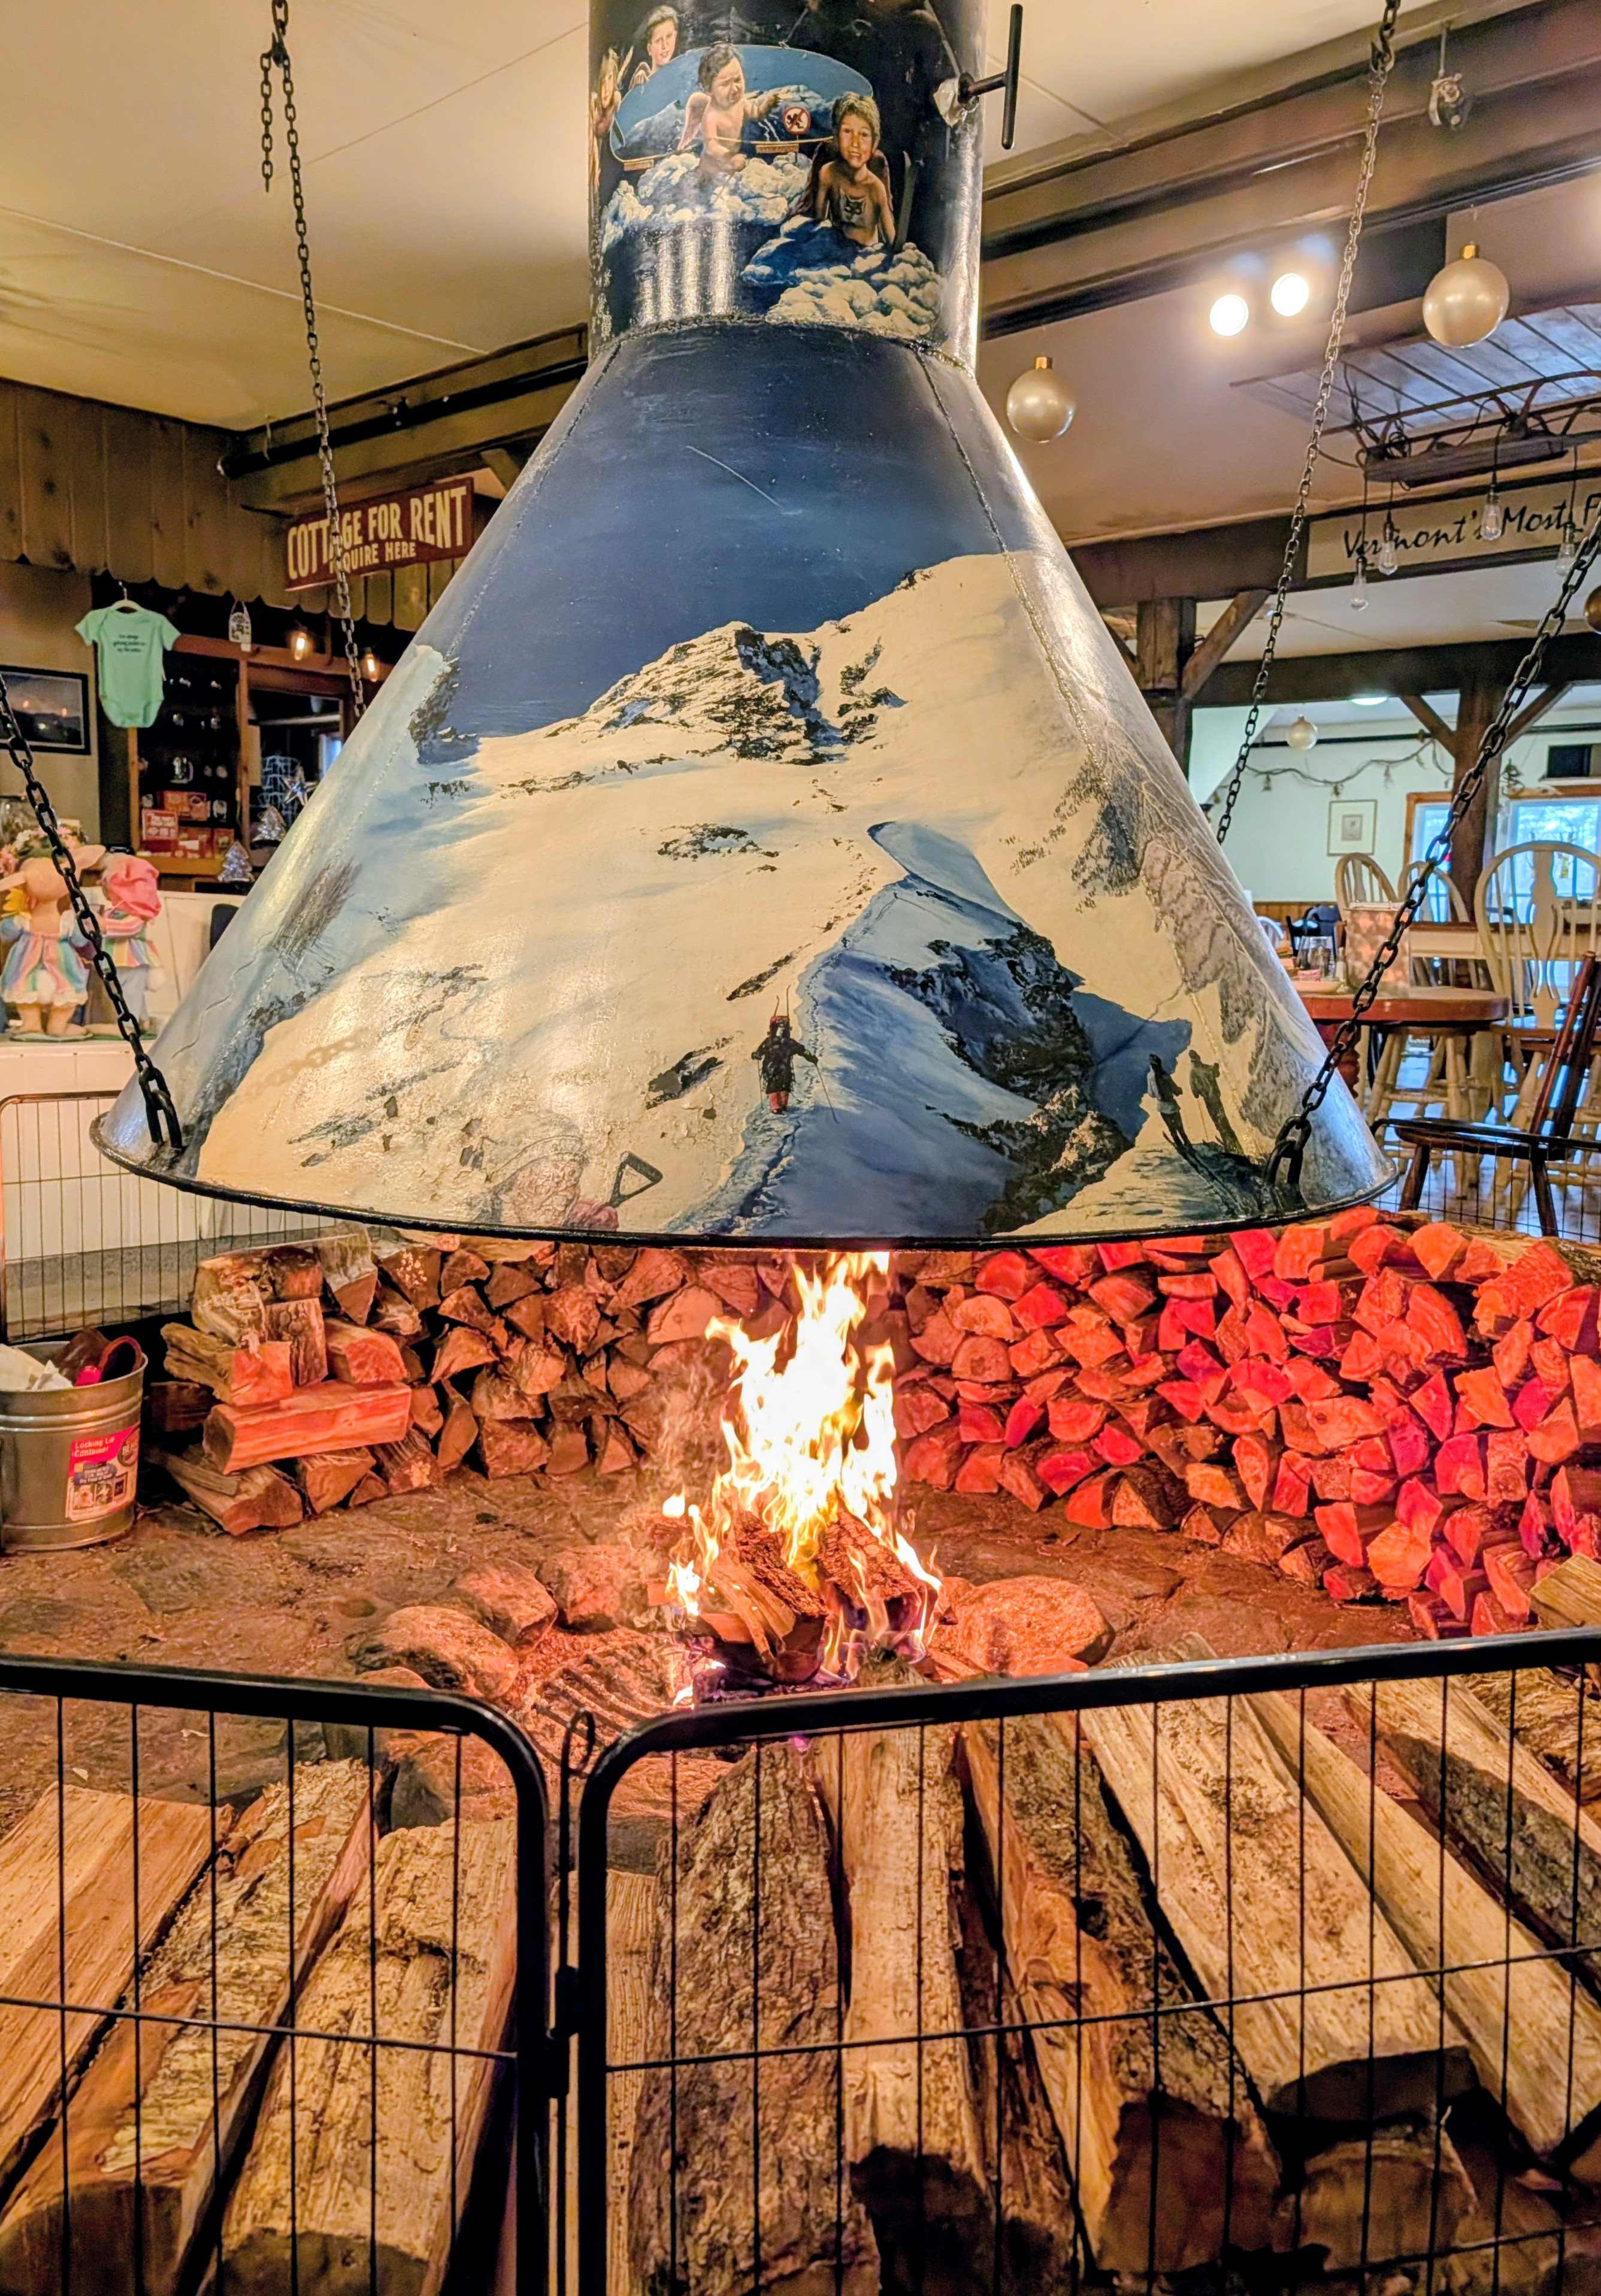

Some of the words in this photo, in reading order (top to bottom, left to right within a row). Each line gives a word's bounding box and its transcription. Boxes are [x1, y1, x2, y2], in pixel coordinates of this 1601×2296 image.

[368, 502, 403, 541] FOR
[410, 486, 467, 549] RENT
[1501, 500, 1567, 537] Most
[385, 541, 416, 562] HERE
[74, 1446, 109, 1458] Container
[75, 1440, 103, 1449] Locking
